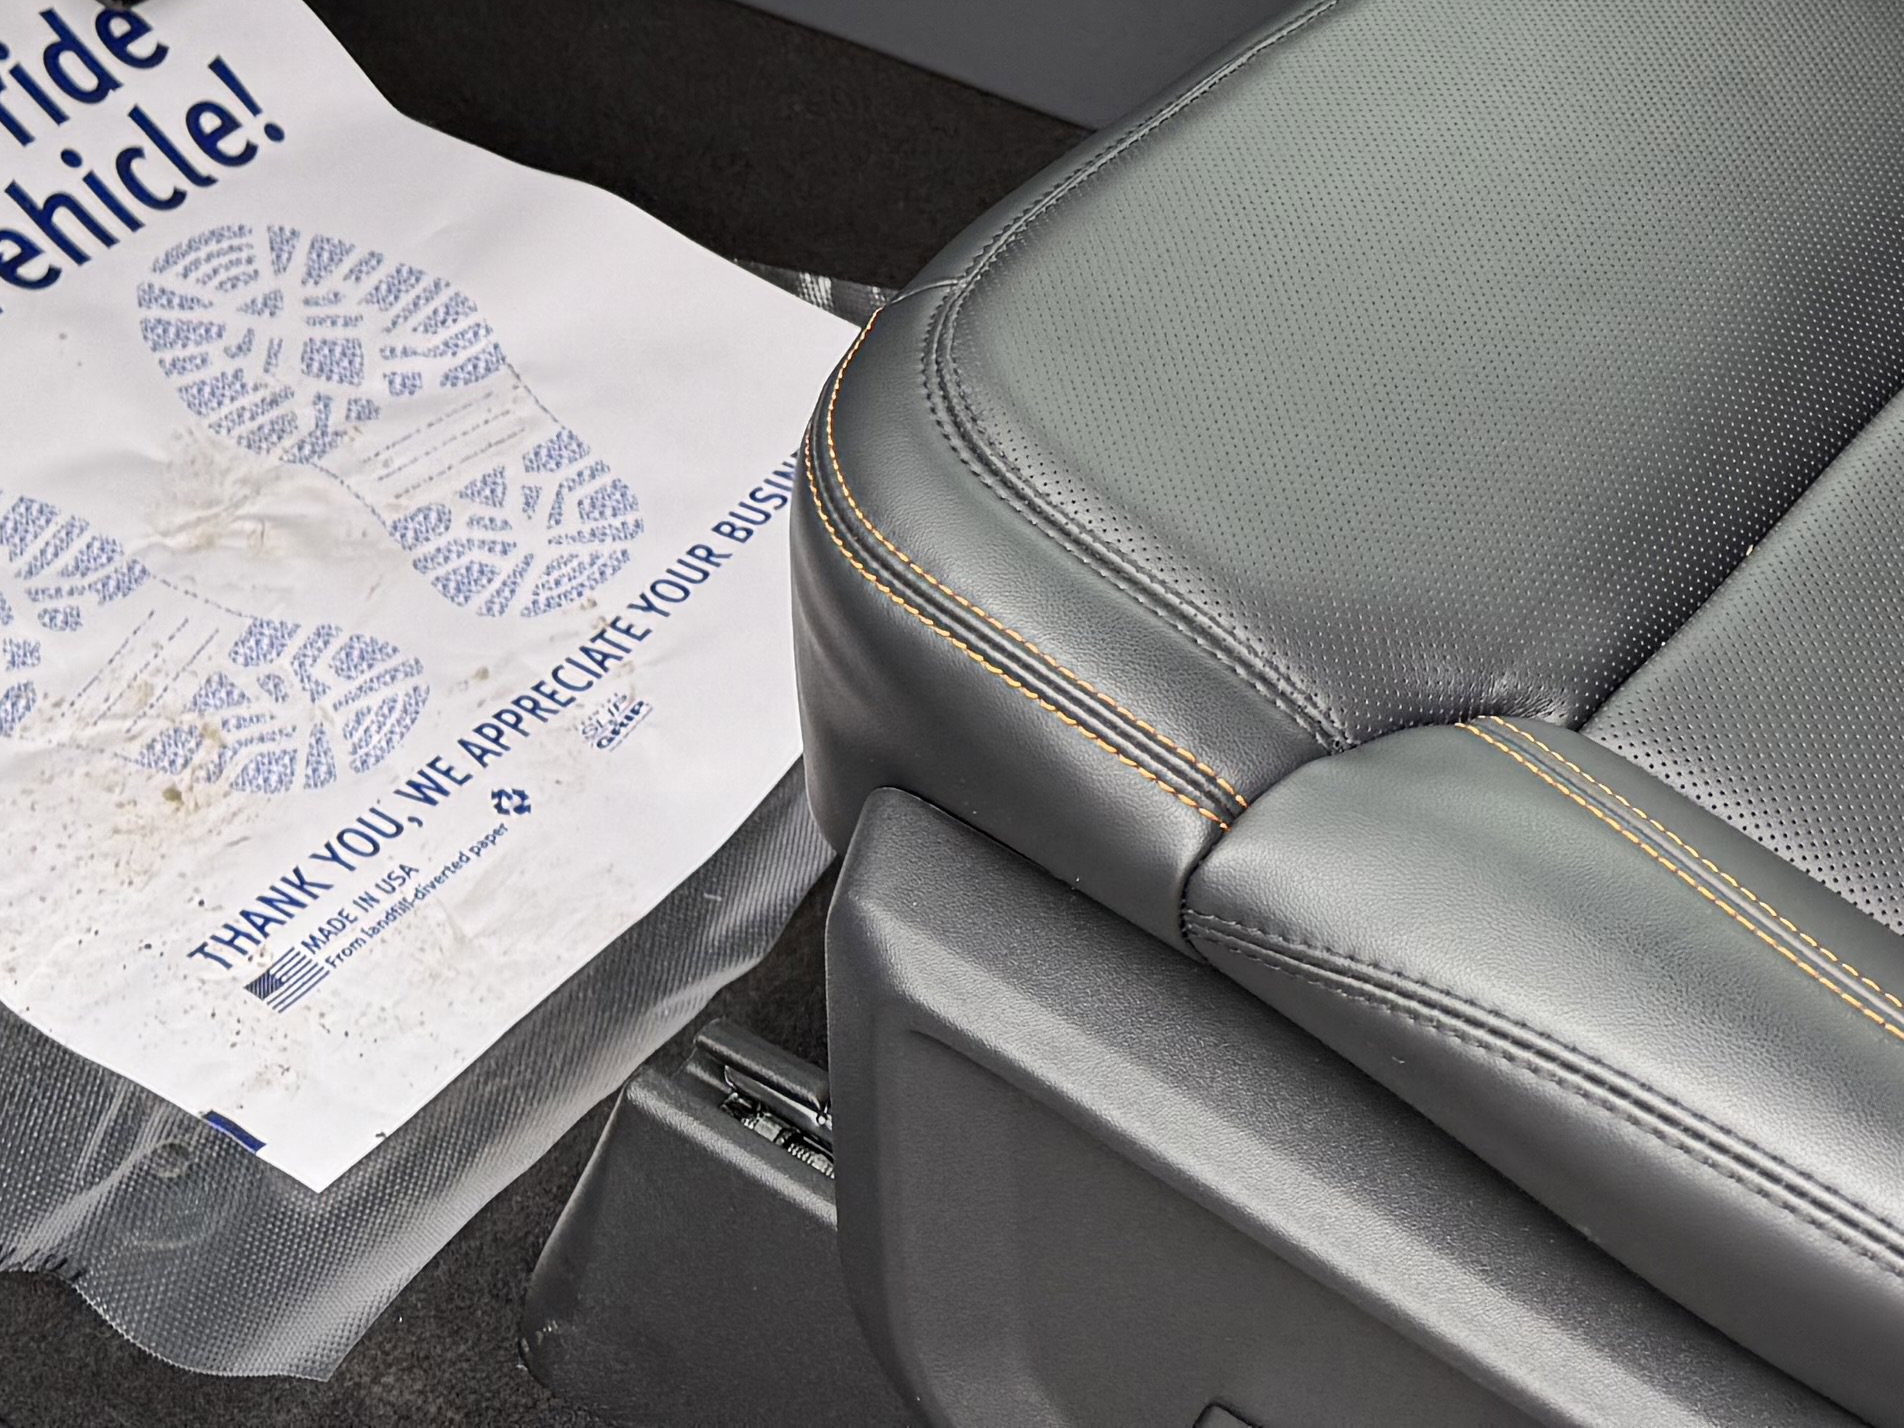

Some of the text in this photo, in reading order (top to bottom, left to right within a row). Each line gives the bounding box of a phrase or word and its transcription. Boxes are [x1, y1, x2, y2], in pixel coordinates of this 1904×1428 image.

[186, 865, 335, 971] THANK
[308, 806, 424, 873] YOU,
[393, 755, 474, 808] WE
[456, 615, 654, 770] APPRECIATE
[626, 543, 734, 619] YOUR
[300, 863, 421, 955] MADE IN USA
[325, 822, 509, 970] From landfill-diverted paper
